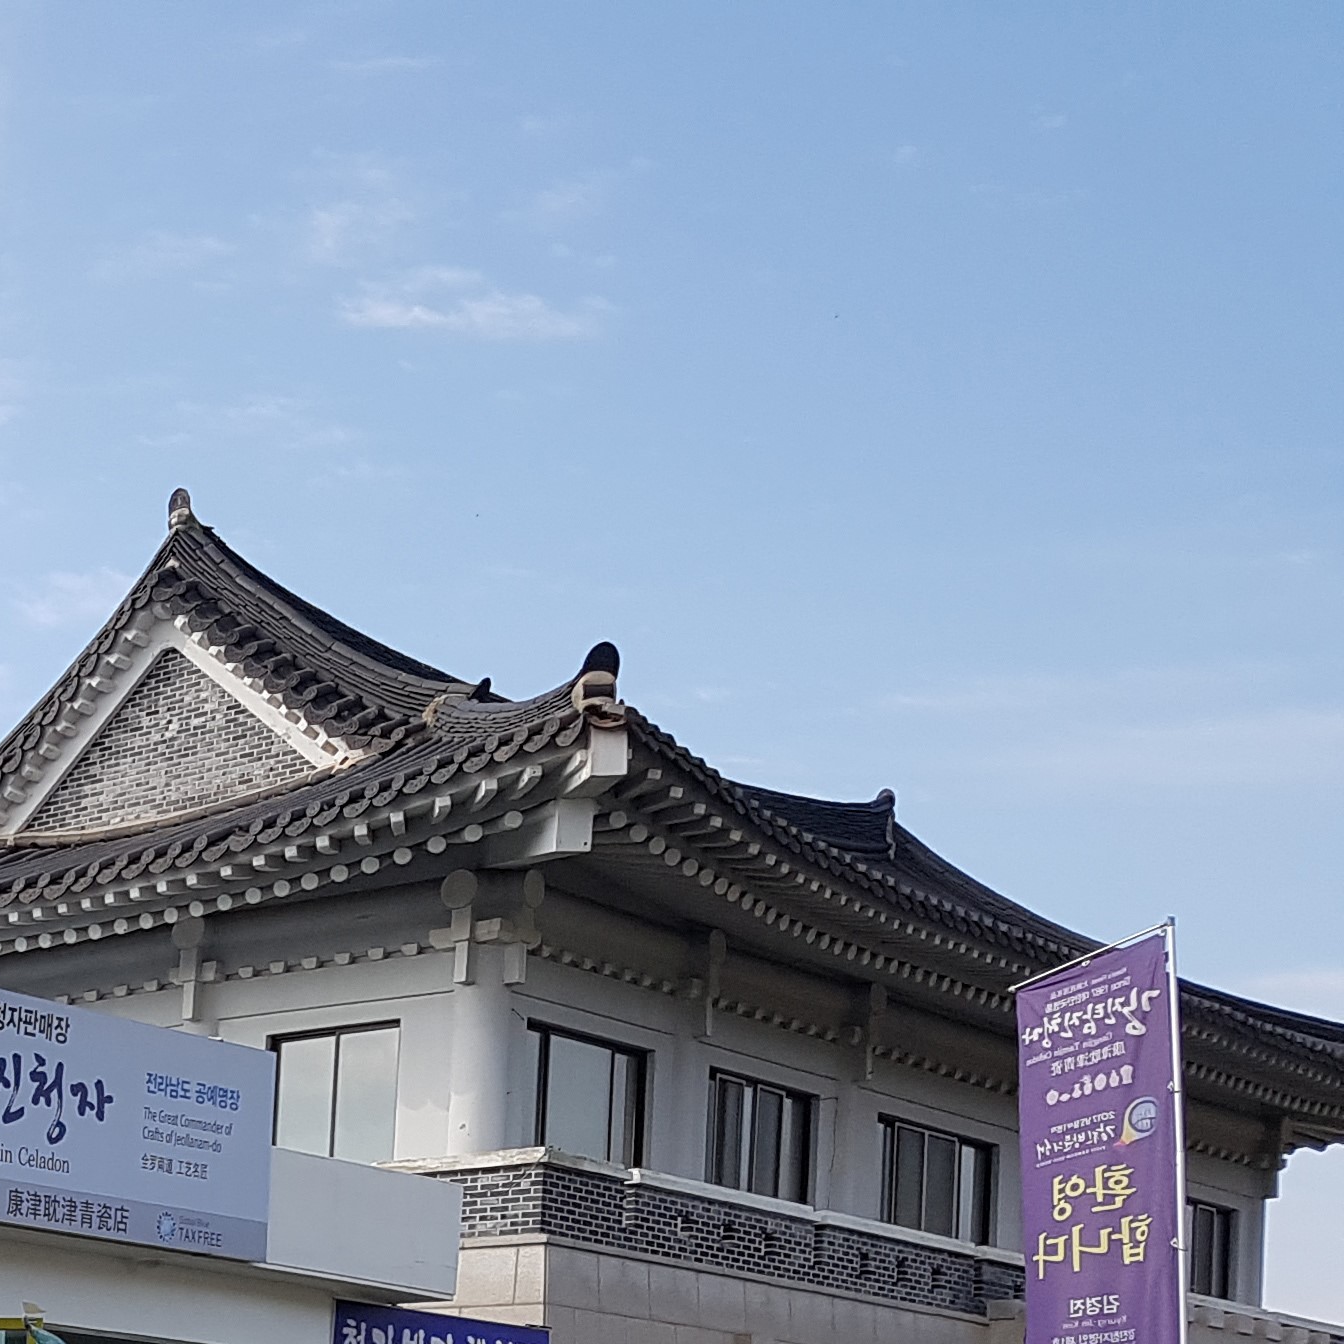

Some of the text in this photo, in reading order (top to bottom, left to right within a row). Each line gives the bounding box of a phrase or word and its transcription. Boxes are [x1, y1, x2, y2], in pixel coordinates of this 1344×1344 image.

[145, 1072, 241, 1112] 전라남도 공예명장
[142, 1126, 165, 1143] Crafts
[165, 1130, 174, 1144] of
[143, 1106, 158, 1122] The
[158, 1109, 179, 1127] Great
[224, 1122, 233, 1136] of
[18, 1146, 71, 1175] Celadon
